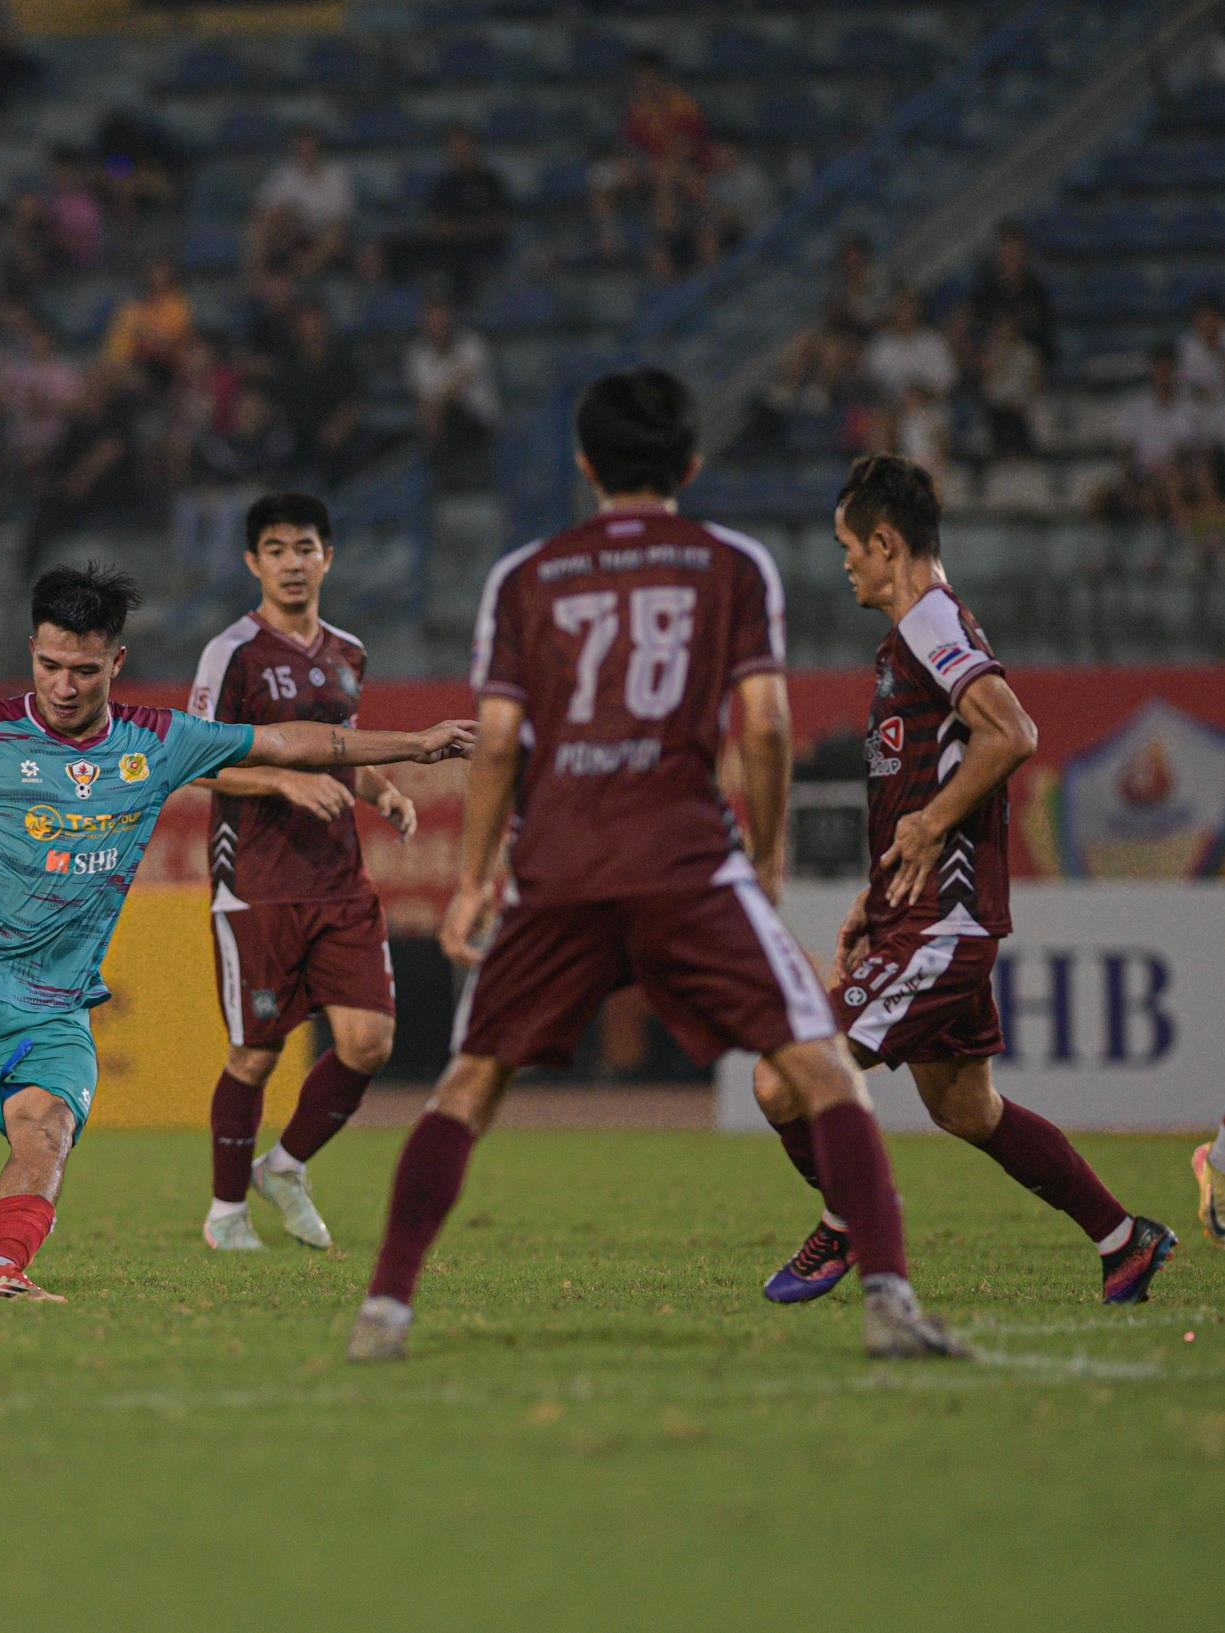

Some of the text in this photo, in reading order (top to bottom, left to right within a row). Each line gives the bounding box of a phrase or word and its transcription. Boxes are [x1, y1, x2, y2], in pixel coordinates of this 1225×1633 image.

[262, 665, 297, 701] 15
[553, 585, 696, 724] 78
[73, 847, 118, 875] SHB
[996, 946, 1179, 1068] HB
